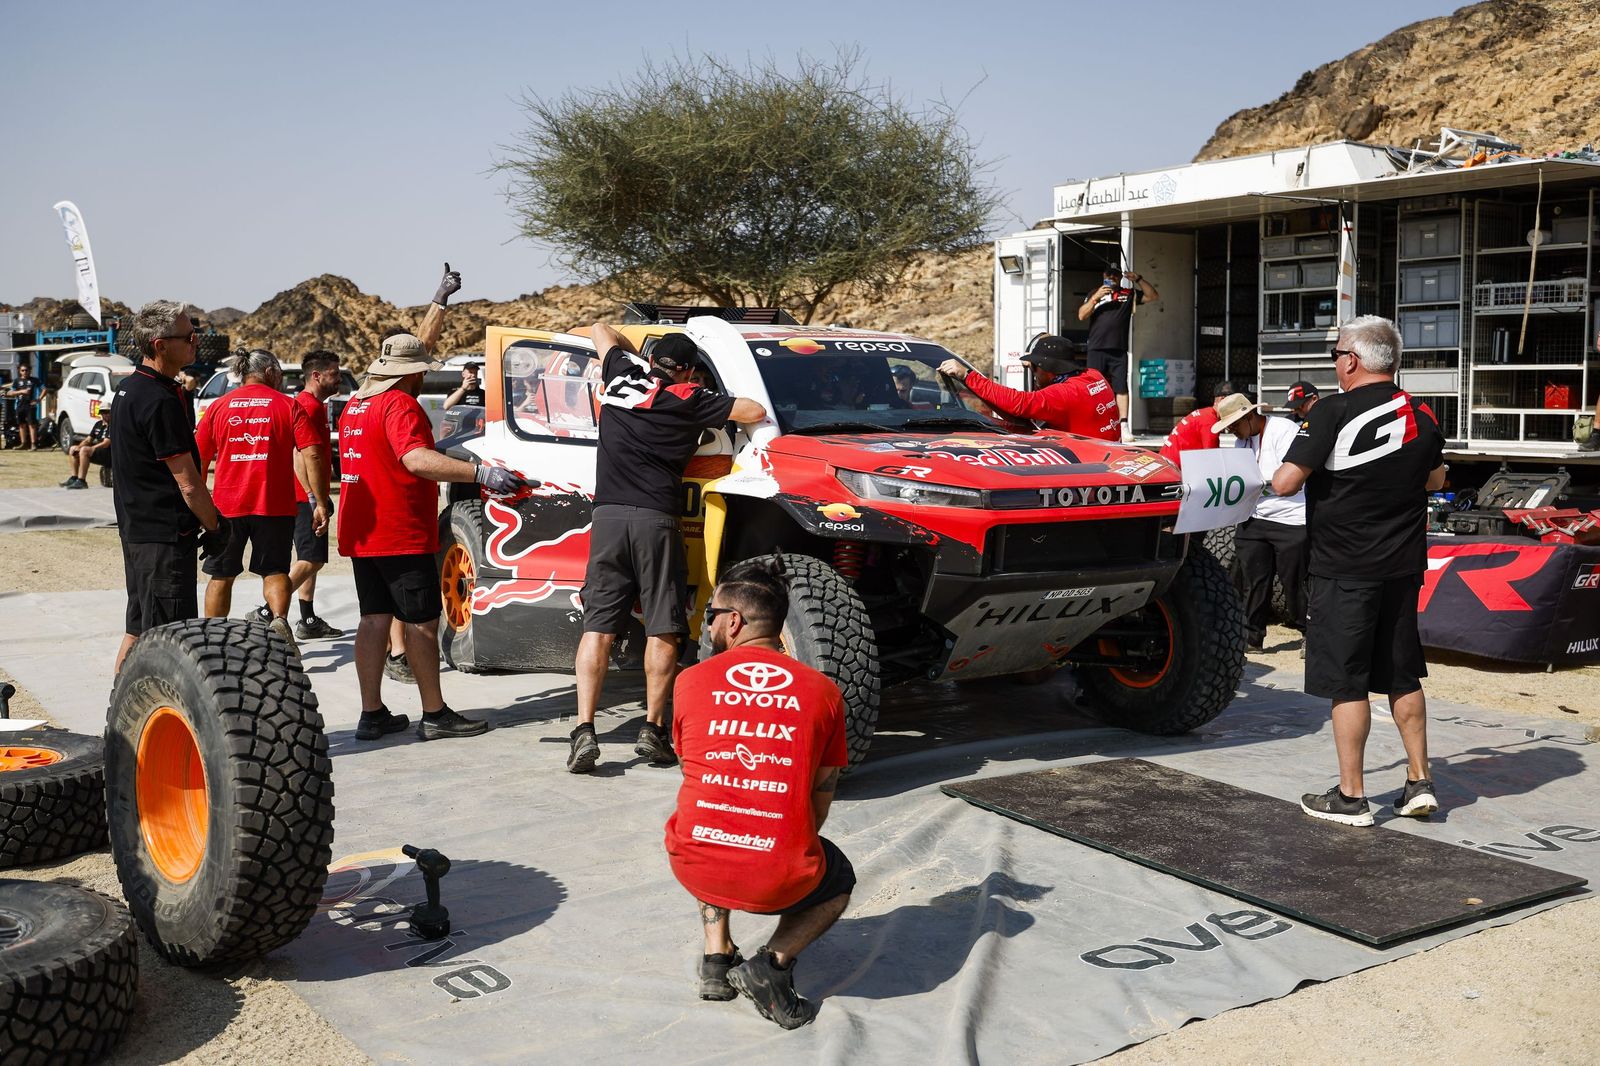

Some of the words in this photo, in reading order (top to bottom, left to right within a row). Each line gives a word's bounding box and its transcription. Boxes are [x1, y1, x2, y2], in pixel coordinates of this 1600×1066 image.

[834, 341, 912, 353] repsol
[996, 448, 1072, 467] Bull
[873, 465, 933, 478] GR
[1039, 484, 1147, 508] TOYOTA
[819, 521, 864, 532] repsol
[1575, 574, 1600, 588] GR
[1566, 638, 1599, 653] HILUX
[711, 691, 801, 711] TOYOTA
[708, 719, 797, 741] HILUX
[701, 773, 788, 793] HALLSPEED
[696, 800, 783, 819] DiverseExtremeTeam.com
[691, 825, 776, 850] BFGoodrich
